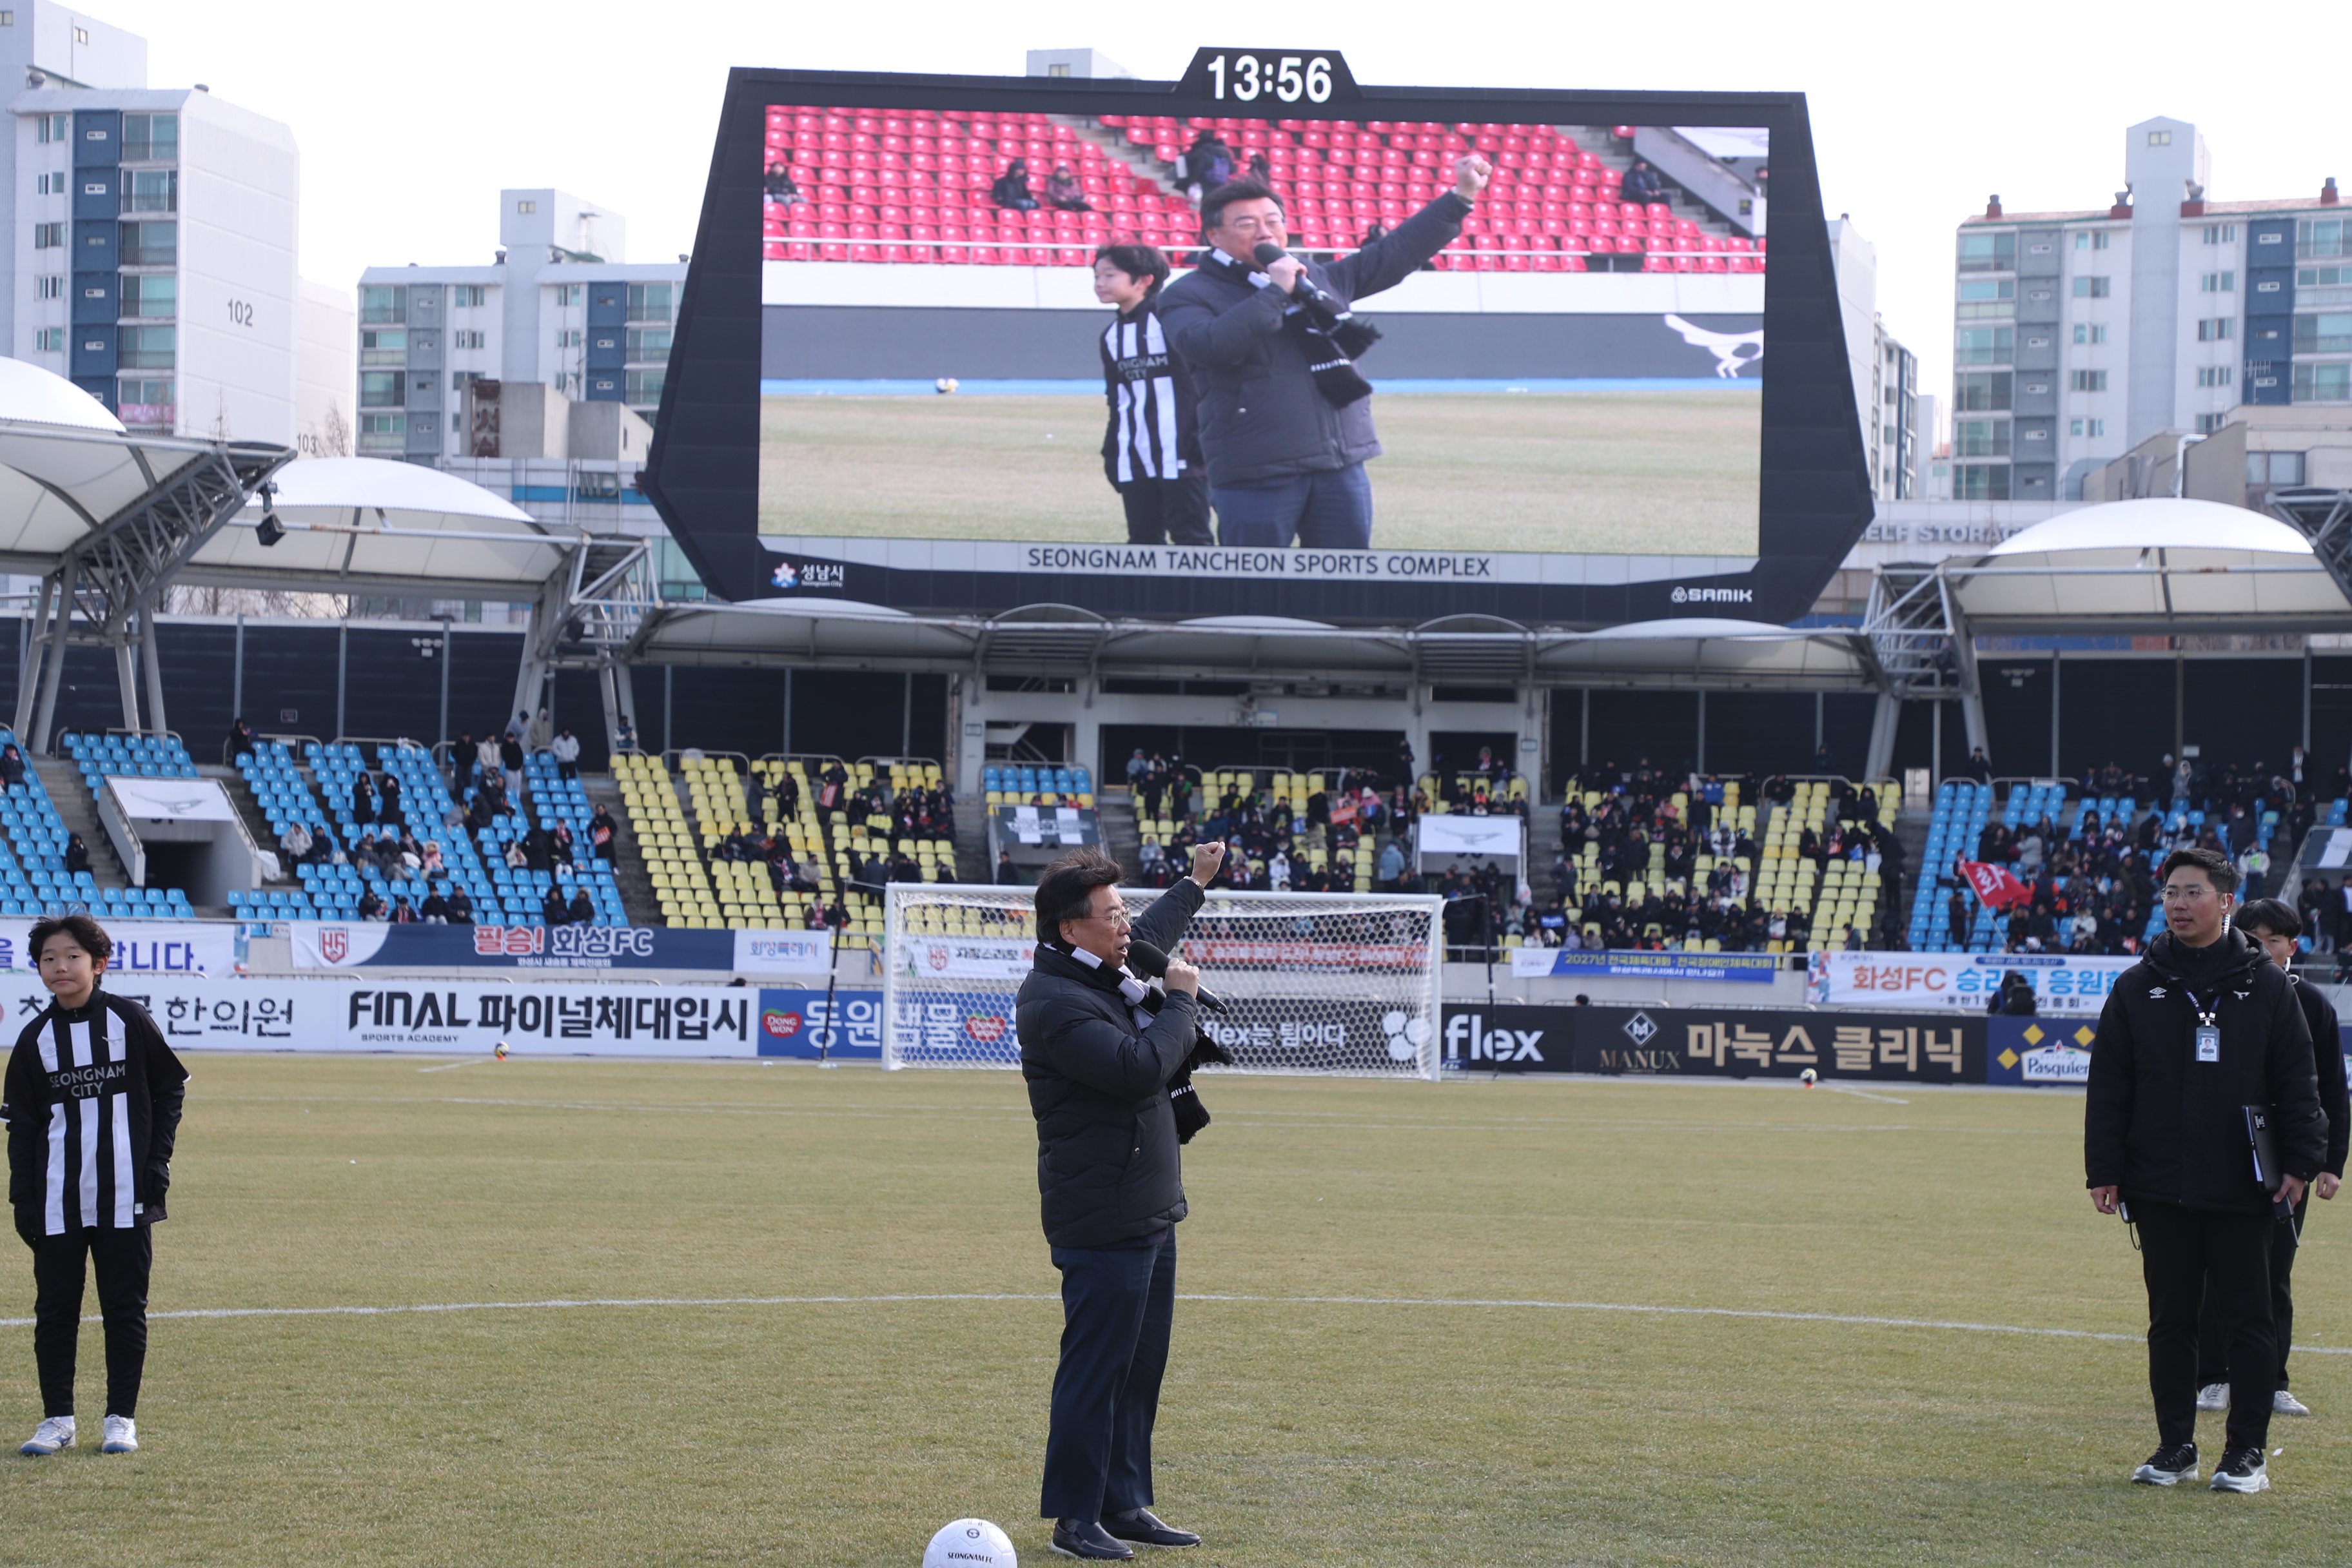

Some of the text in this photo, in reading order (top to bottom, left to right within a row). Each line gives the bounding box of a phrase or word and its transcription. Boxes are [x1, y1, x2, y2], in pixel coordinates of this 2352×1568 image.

[1208, 55, 1332, 103] 13:56
[227, 299, 253, 328] 102
[296, 433, 317, 453] 103
[1860, 524, 1910, 542] ELF
[801, 564, 843, 581] 성남시
[1028, 549, 1490, 576] SEONGNAM TANCHEON SPORTS COMPLEX
[1688, 589, 1752, 603] SAMIK
[473, 925, 654, 957] 필승! 화성FC
[1565, 953, 1605, 965] 2027년
[1853, 965, 1946, 991] 화성FC
[165, 997, 293, 1037] 한의원
[349, 991, 748, 1041] FINAL 파이널체대입시
[767, 1015, 798, 1026] DONG
[362, 1034, 460, 1043] SPORTS ACADEMY
[1445, 1014, 1545, 1062] flex
[1687, 1022, 1963, 1073] 마눅스 클리닉
[1600, 1048, 1681, 1070] MANUX
[2028, 1058, 2089, 1077] Pasquier
[50, 1064, 125, 1088] SEONGNAM
[71, 1081, 103, 1097] CITY
[947, 1552, 984, 1563] SEONGNAM
